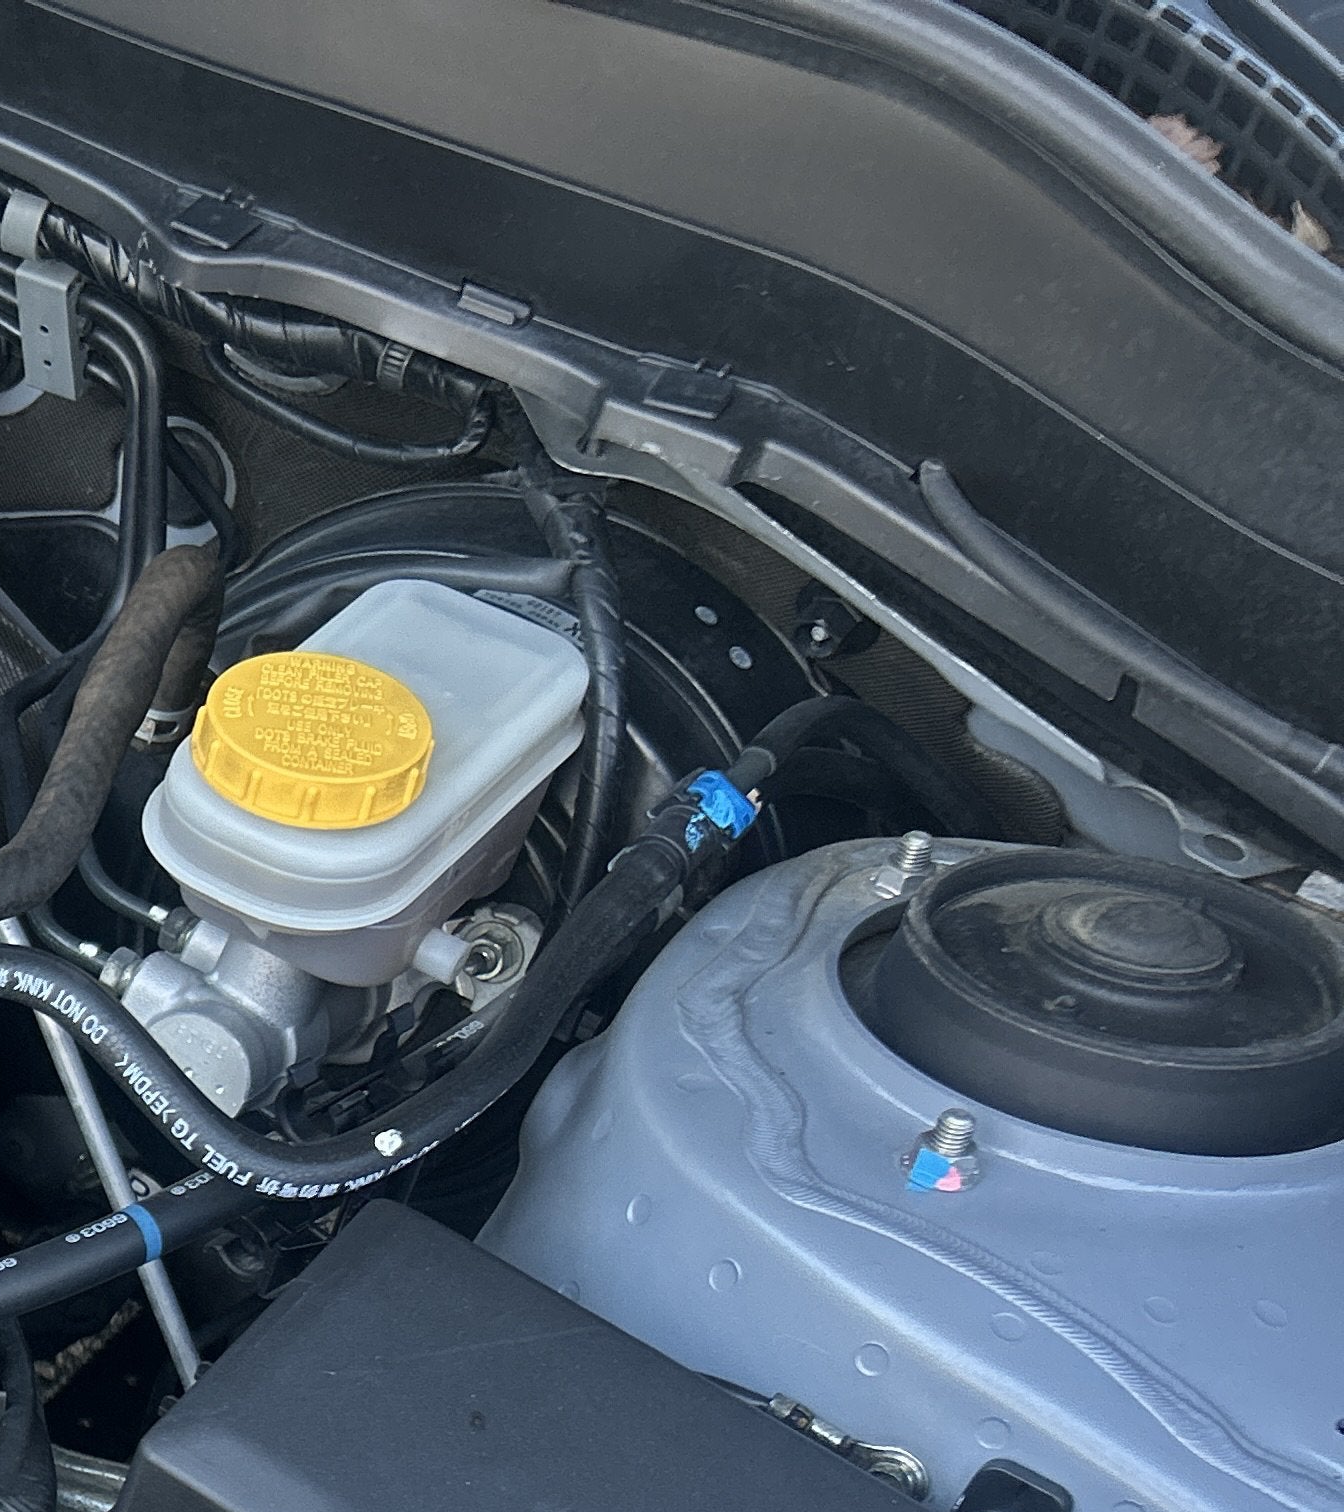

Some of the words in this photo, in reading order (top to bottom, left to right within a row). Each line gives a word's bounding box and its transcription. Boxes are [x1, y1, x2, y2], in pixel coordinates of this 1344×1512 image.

[290, 656, 355, 675] WARNING
[356, 676, 383, 689] CAP
[282, 755, 354, 776] CONTAINER
[48, 989, 87, 1026] NOT
[81, 1013, 109, 1045] DO
[169, 1118, 203, 1151] TG
[200, 1144, 256, 1187] FUEL
[79, 1212, 128, 1238] 6603
